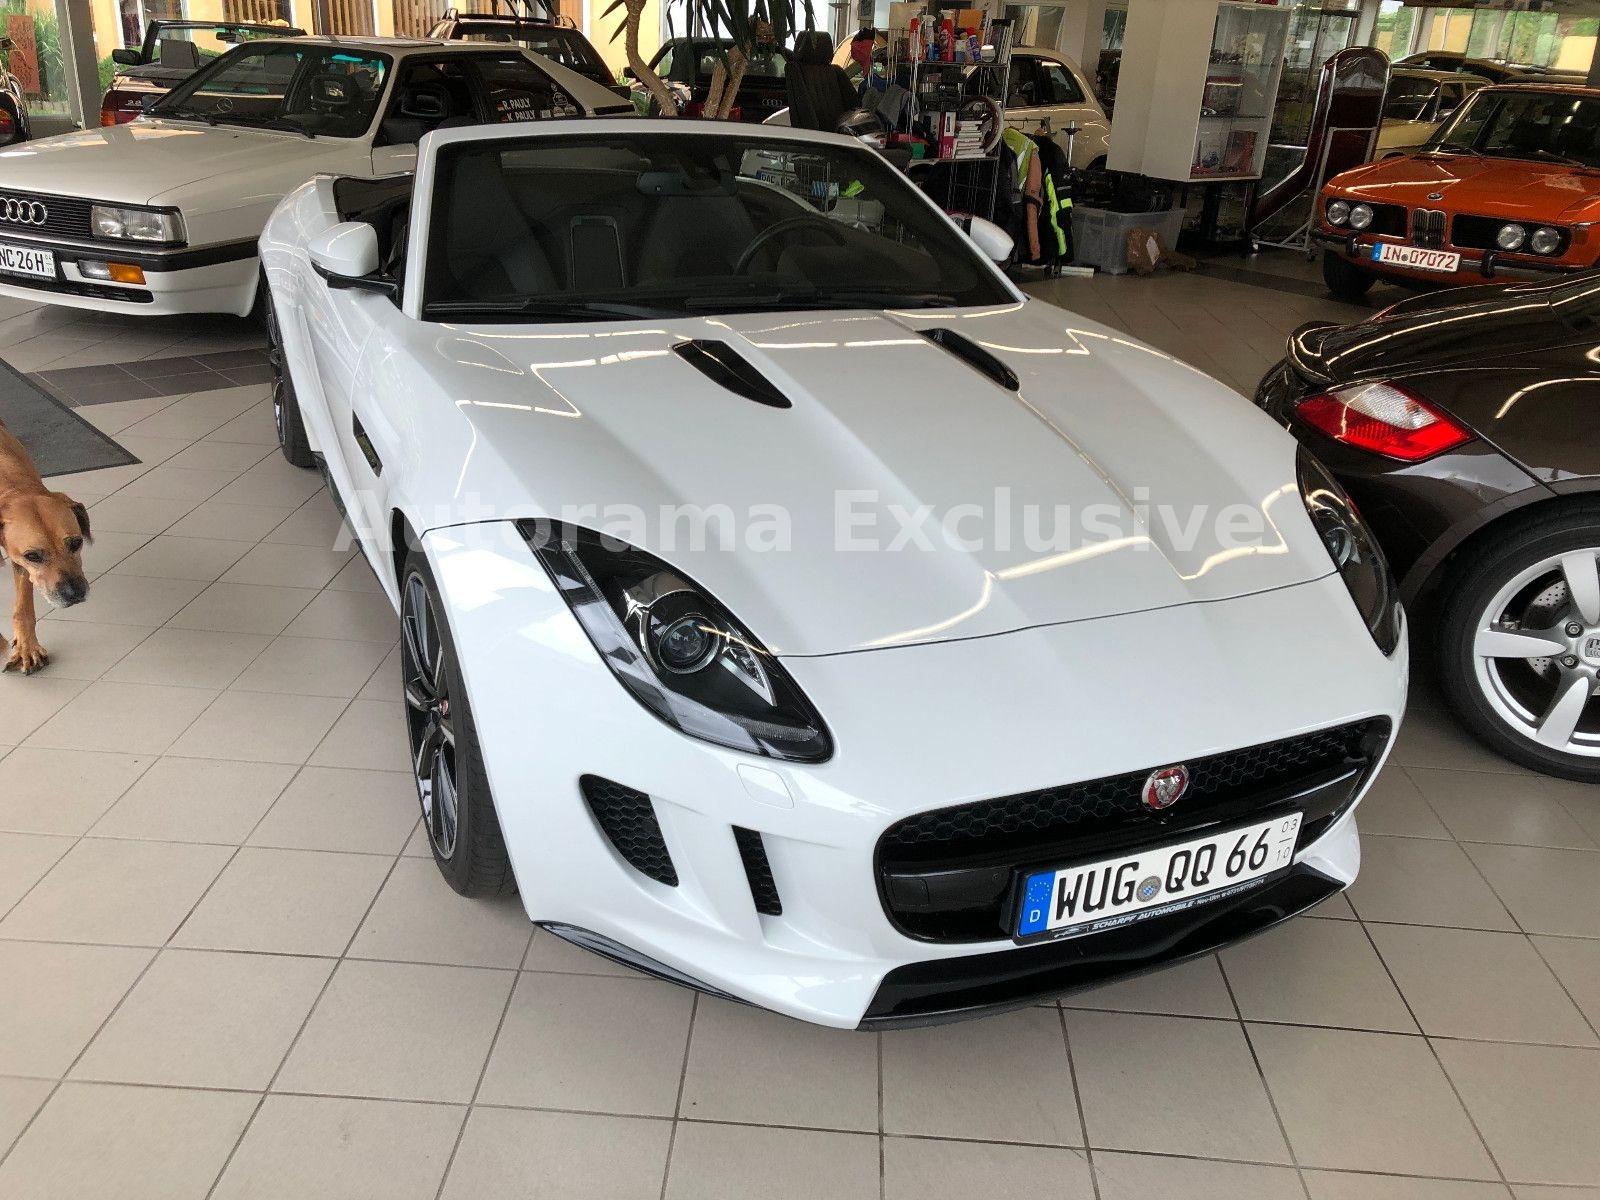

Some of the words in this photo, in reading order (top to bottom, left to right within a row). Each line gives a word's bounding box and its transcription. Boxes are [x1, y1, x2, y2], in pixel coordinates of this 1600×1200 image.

[510, 97, 531, 110] PAULY
[16, 250, 33, 271] 26
[34, 252, 45, 273] H
[1383, 246, 1403, 262] IN
[1409, 250, 1456, 270] 07072
[1029, 909, 1041, 923] D
[1055, 861, 1140, 921] WUG
[1165, 843, 1218, 894] QQ
[1225, 827, 1271, 878] 66
